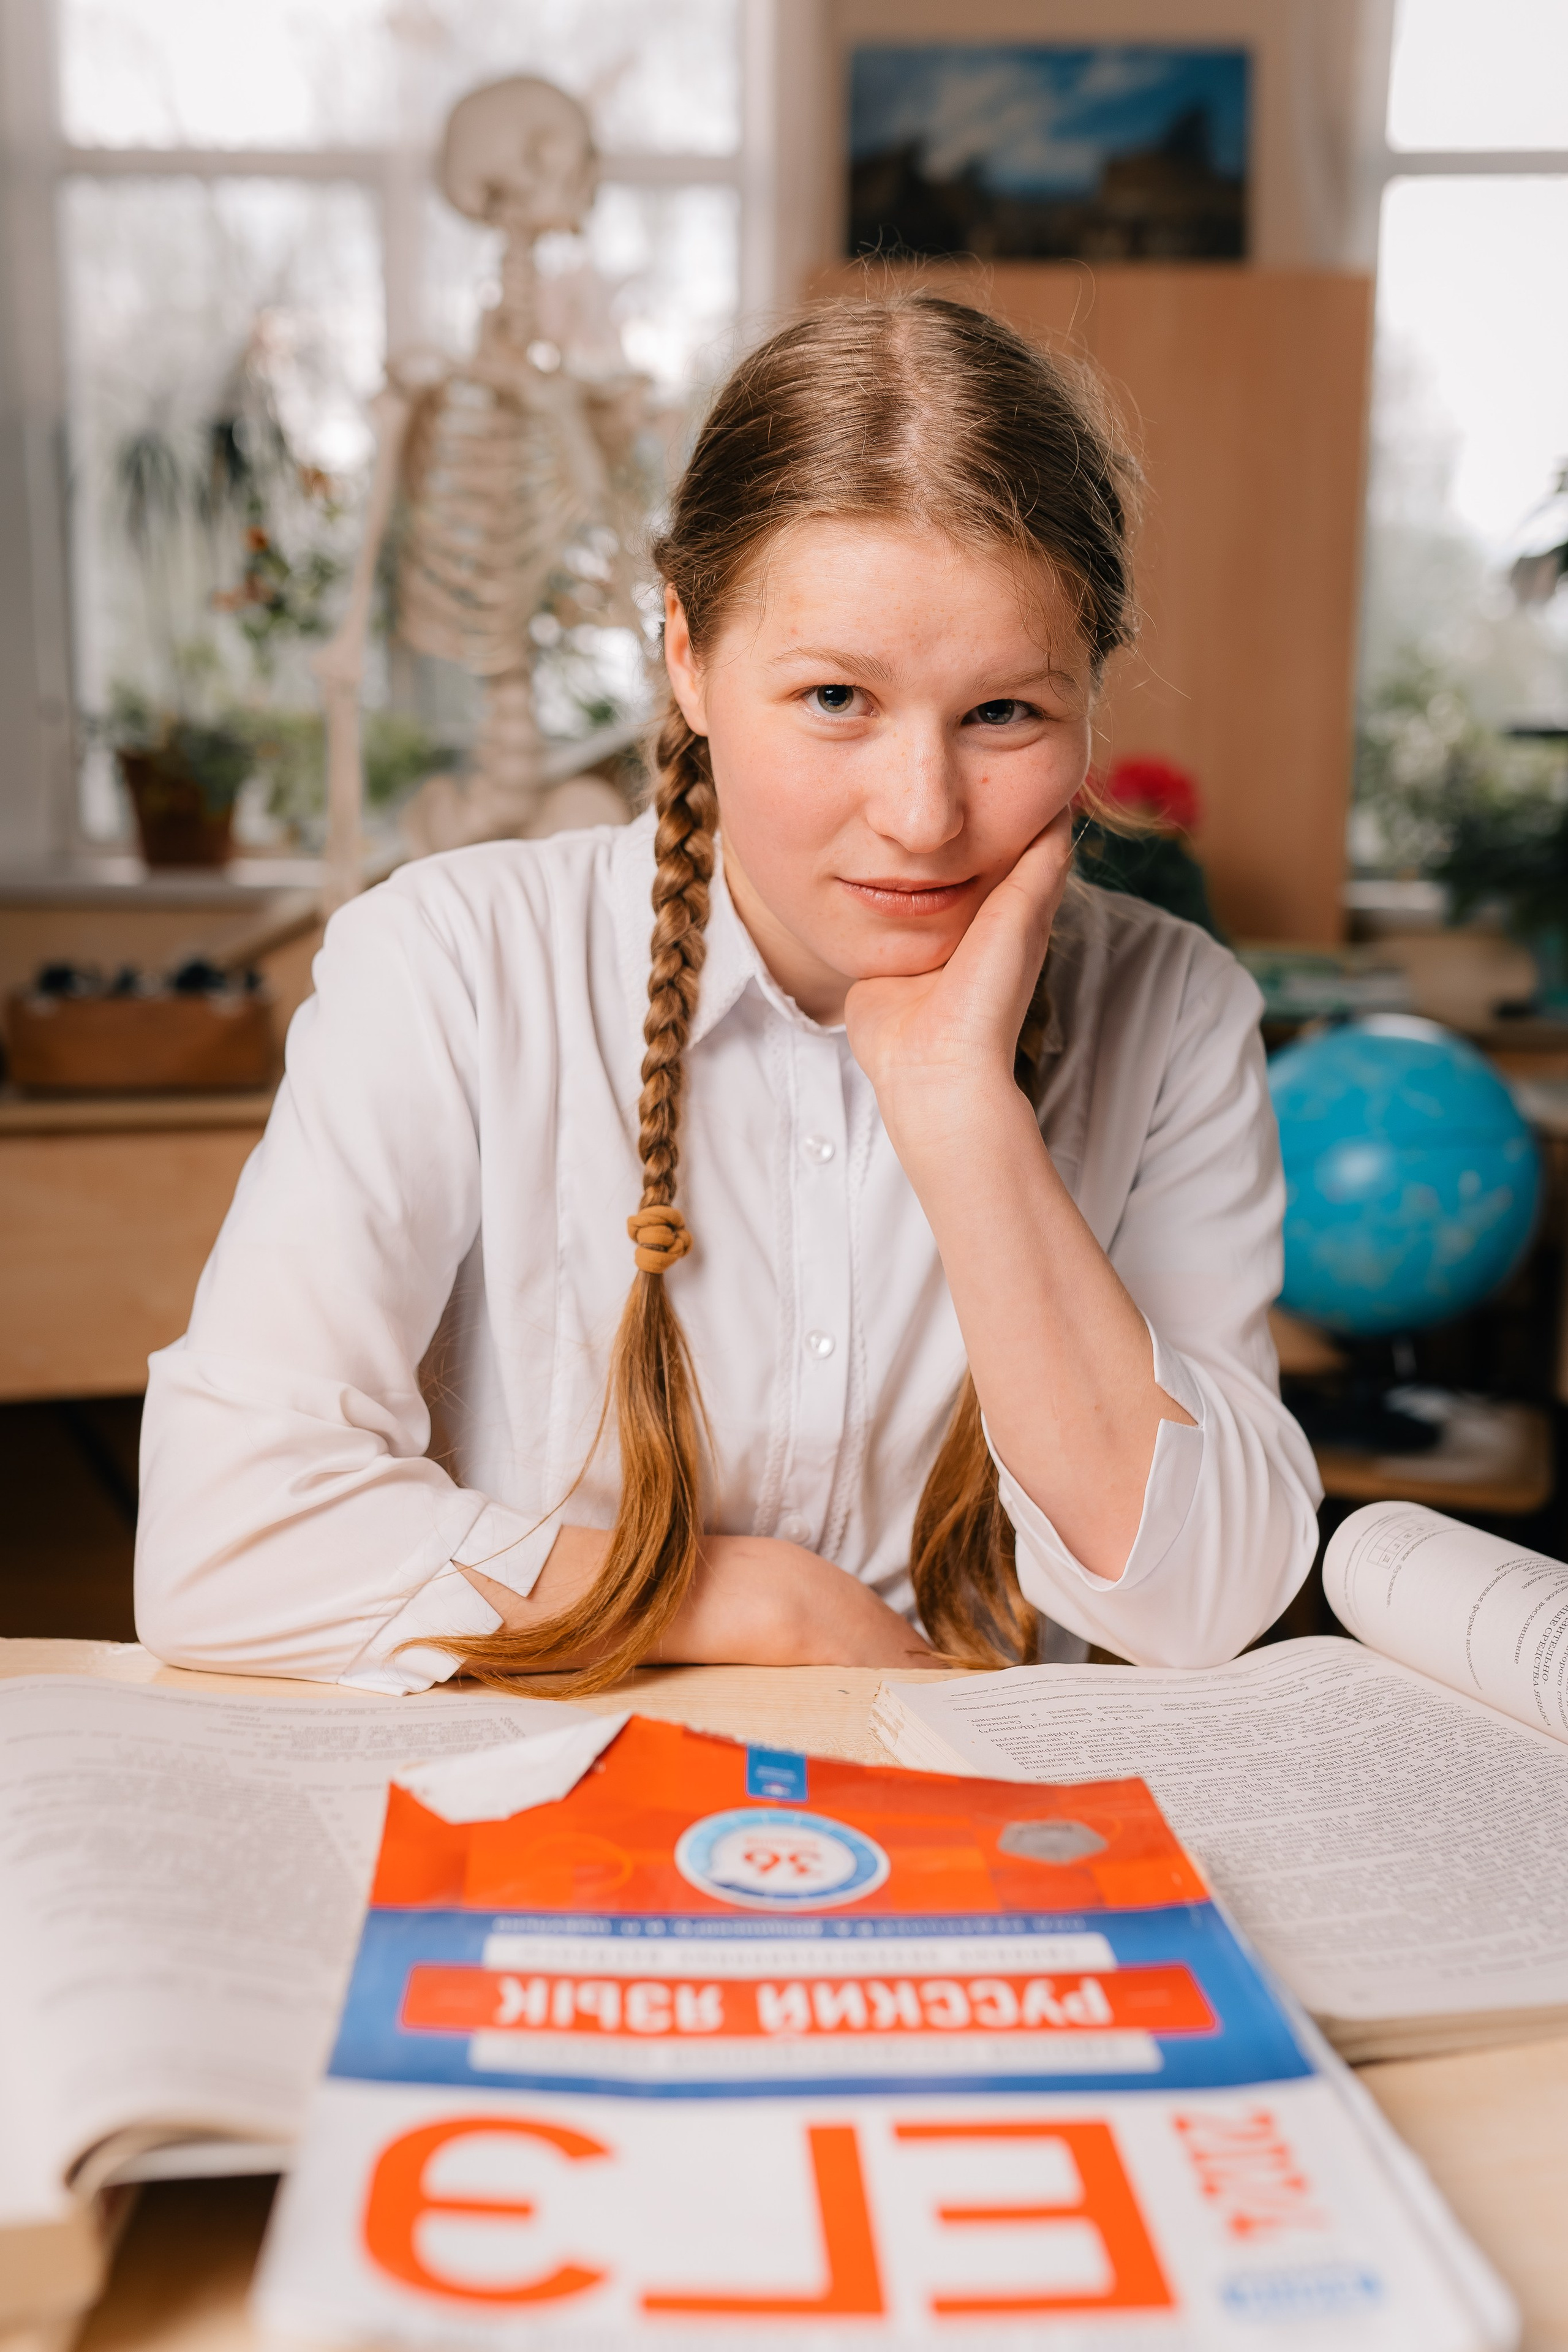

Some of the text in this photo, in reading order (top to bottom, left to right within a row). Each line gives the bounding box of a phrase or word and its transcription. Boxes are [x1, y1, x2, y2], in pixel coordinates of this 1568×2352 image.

[1466, 1604, 1480, 1636] форма
[1514, 1602, 1545, 1664] восклицание
[1533, 1627, 1552, 1686] СРЕДСТВА
[1542, 1618, 1568, 1684] ЗИТЕЛЬНО-
[953, 1698, 1029, 1711] (преимущественно
[1534, 1689, 1551, 1726] ЯЗЫКА
[972, 1712, 1094, 1729] фамилия Салтыков,
[1354, 1709, 1381, 1721] (21)Я
[978, 1719, 1091, 1734] Салтыкову-Щедрину)
[1297, 1724, 1332, 1734] говорю
[1313, 1722, 1361, 1736] несчастие
[1343, 1721, 1397, 1740] (19)Только
[1362, 1721, 1416, 1740] утрачивает
[1173, 1732, 1234, 1741] ненавистью,
[1402, 1736, 1424, 1745] своё
[1414, 1731, 1458, 1747] общения
[1460, 1729, 1494, 1740] биение
[995, 1738, 1065, 1747] читательской
[1047, 1739, 1107, 1748] улыбнулось
[1086, 1743, 1174, 1754] изолированности,
[1088, 1740, 1152, 1749] бесчестными
[1284, 1743, 1317, 1752] вопрос
[1311, 1740, 1352, 1752] ясность,
[1316, 1727, 1431, 1762] бормотаний случайных
[1428, 1742, 1461, 1755] горят,
[1465, 1740, 1494, 1749] силах
[1496, 1743, 1542, 1752] условиях
[1156, 1727, 1415, 1778] наудачу, речь писателя превращается назойливое
[1246, 1751, 1302, 1763] внутреннее
[1345, 1743, 1400, 1761] призвание.
[1378, 1746, 1411, 1758] между
[1384, 1748, 1425, 1762] слышно
[1420, 1749, 1459, 1764] объять,
[1444, 1749, 1478, 1762] окрест
[1487, 1750, 1522, 1761] полное
[1152, 1758, 1219, 1768] определённо:
[1177, 1761, 1237, 1770] содержание
[1280, 1759, 1343, 1774] (16)Могучий
[1324, 1757, 1375, 1771] читателем
[1348, 1761, 1382, 1772] сквозь
[1380, 1759, 1408, 1770] огонь
[1387, 1763, 1415, 1774] тогда
[1456, 1759, 1485, 1771] право
[1253, 1771, 1308, 1782] писателем,
[1313, 1770, 1345, 1779] толщу
[1414, 1768, 1441, 1779] были
[1416, 1765, 1487, 1790] справедливом
[1194, 1780, 1249, 1789] последний
[1289, 1776, 1342, 1788] проницает
[1329, 1778, 1362, 1787] может
[1351, 1774, 1398, 1789] глубокая
[1376, 1777, 1411, 1789] только
[1386, 1770, 1454, 1792] воскликнуть,
[742, 1850, 824, 1880] 36
[492, 1977, 1115, 2043] РУССКИЙ ЯЗЫК
[360, 2114, 1180, 2321] ЕГЭ
